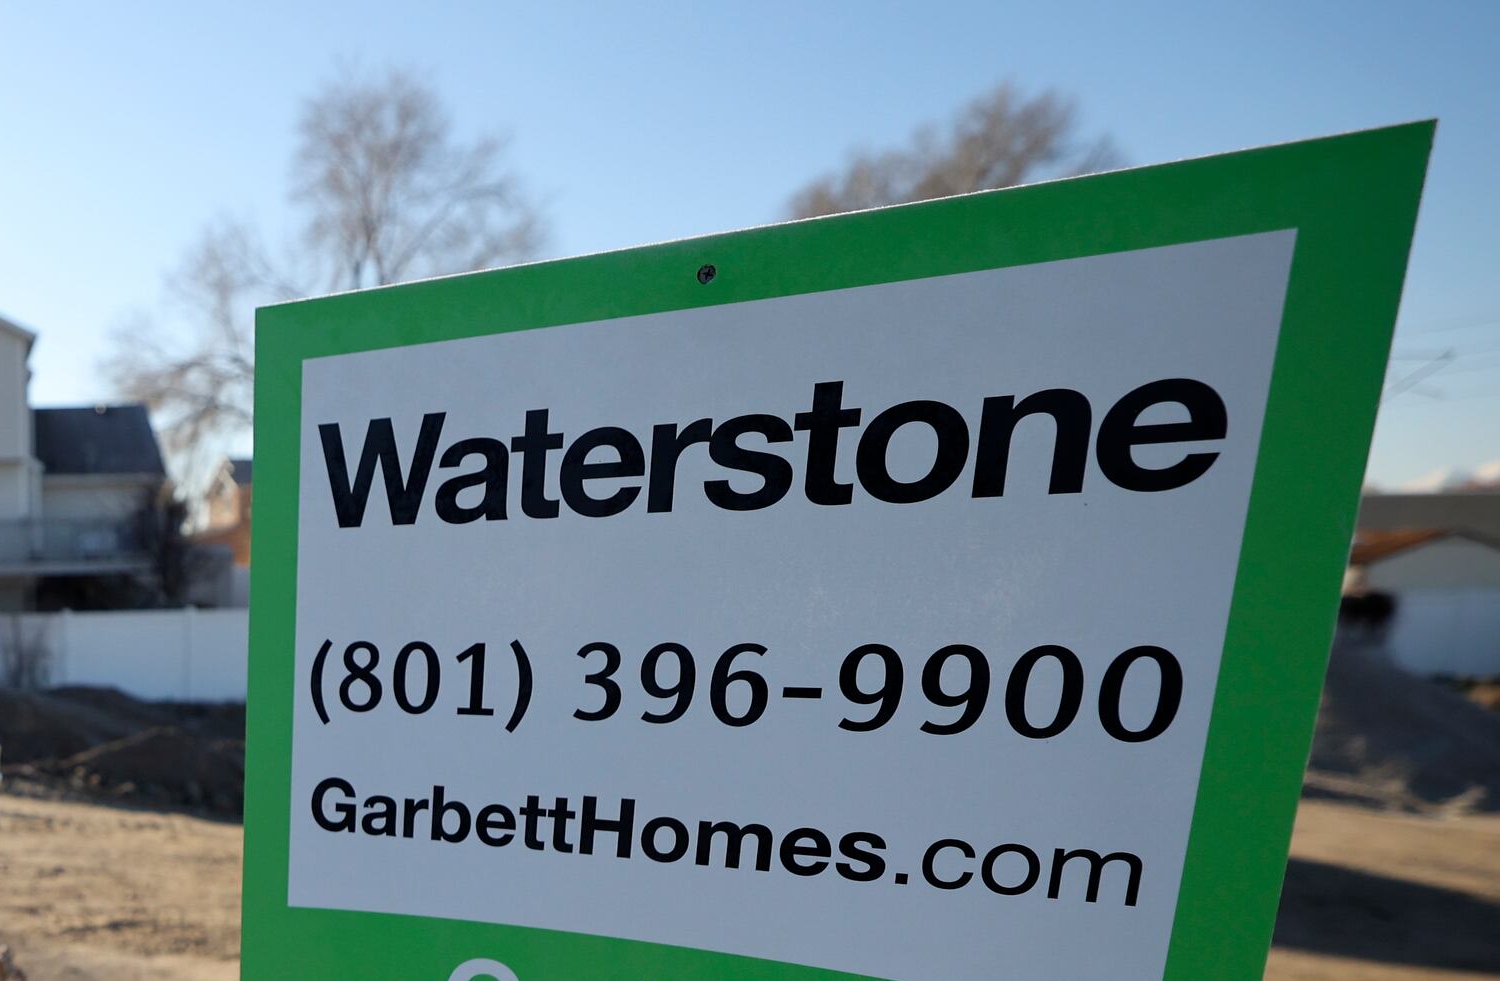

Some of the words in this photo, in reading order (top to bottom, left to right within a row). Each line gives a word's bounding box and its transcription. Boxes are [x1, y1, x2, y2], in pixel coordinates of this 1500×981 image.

[318, 378, 1228, 528] Waterstone
[310, 638, 533, 733] (801)
[573, 641, 1184, 743] 396-9900
[310, 777, 1143, 907] GarbettHomes.com
